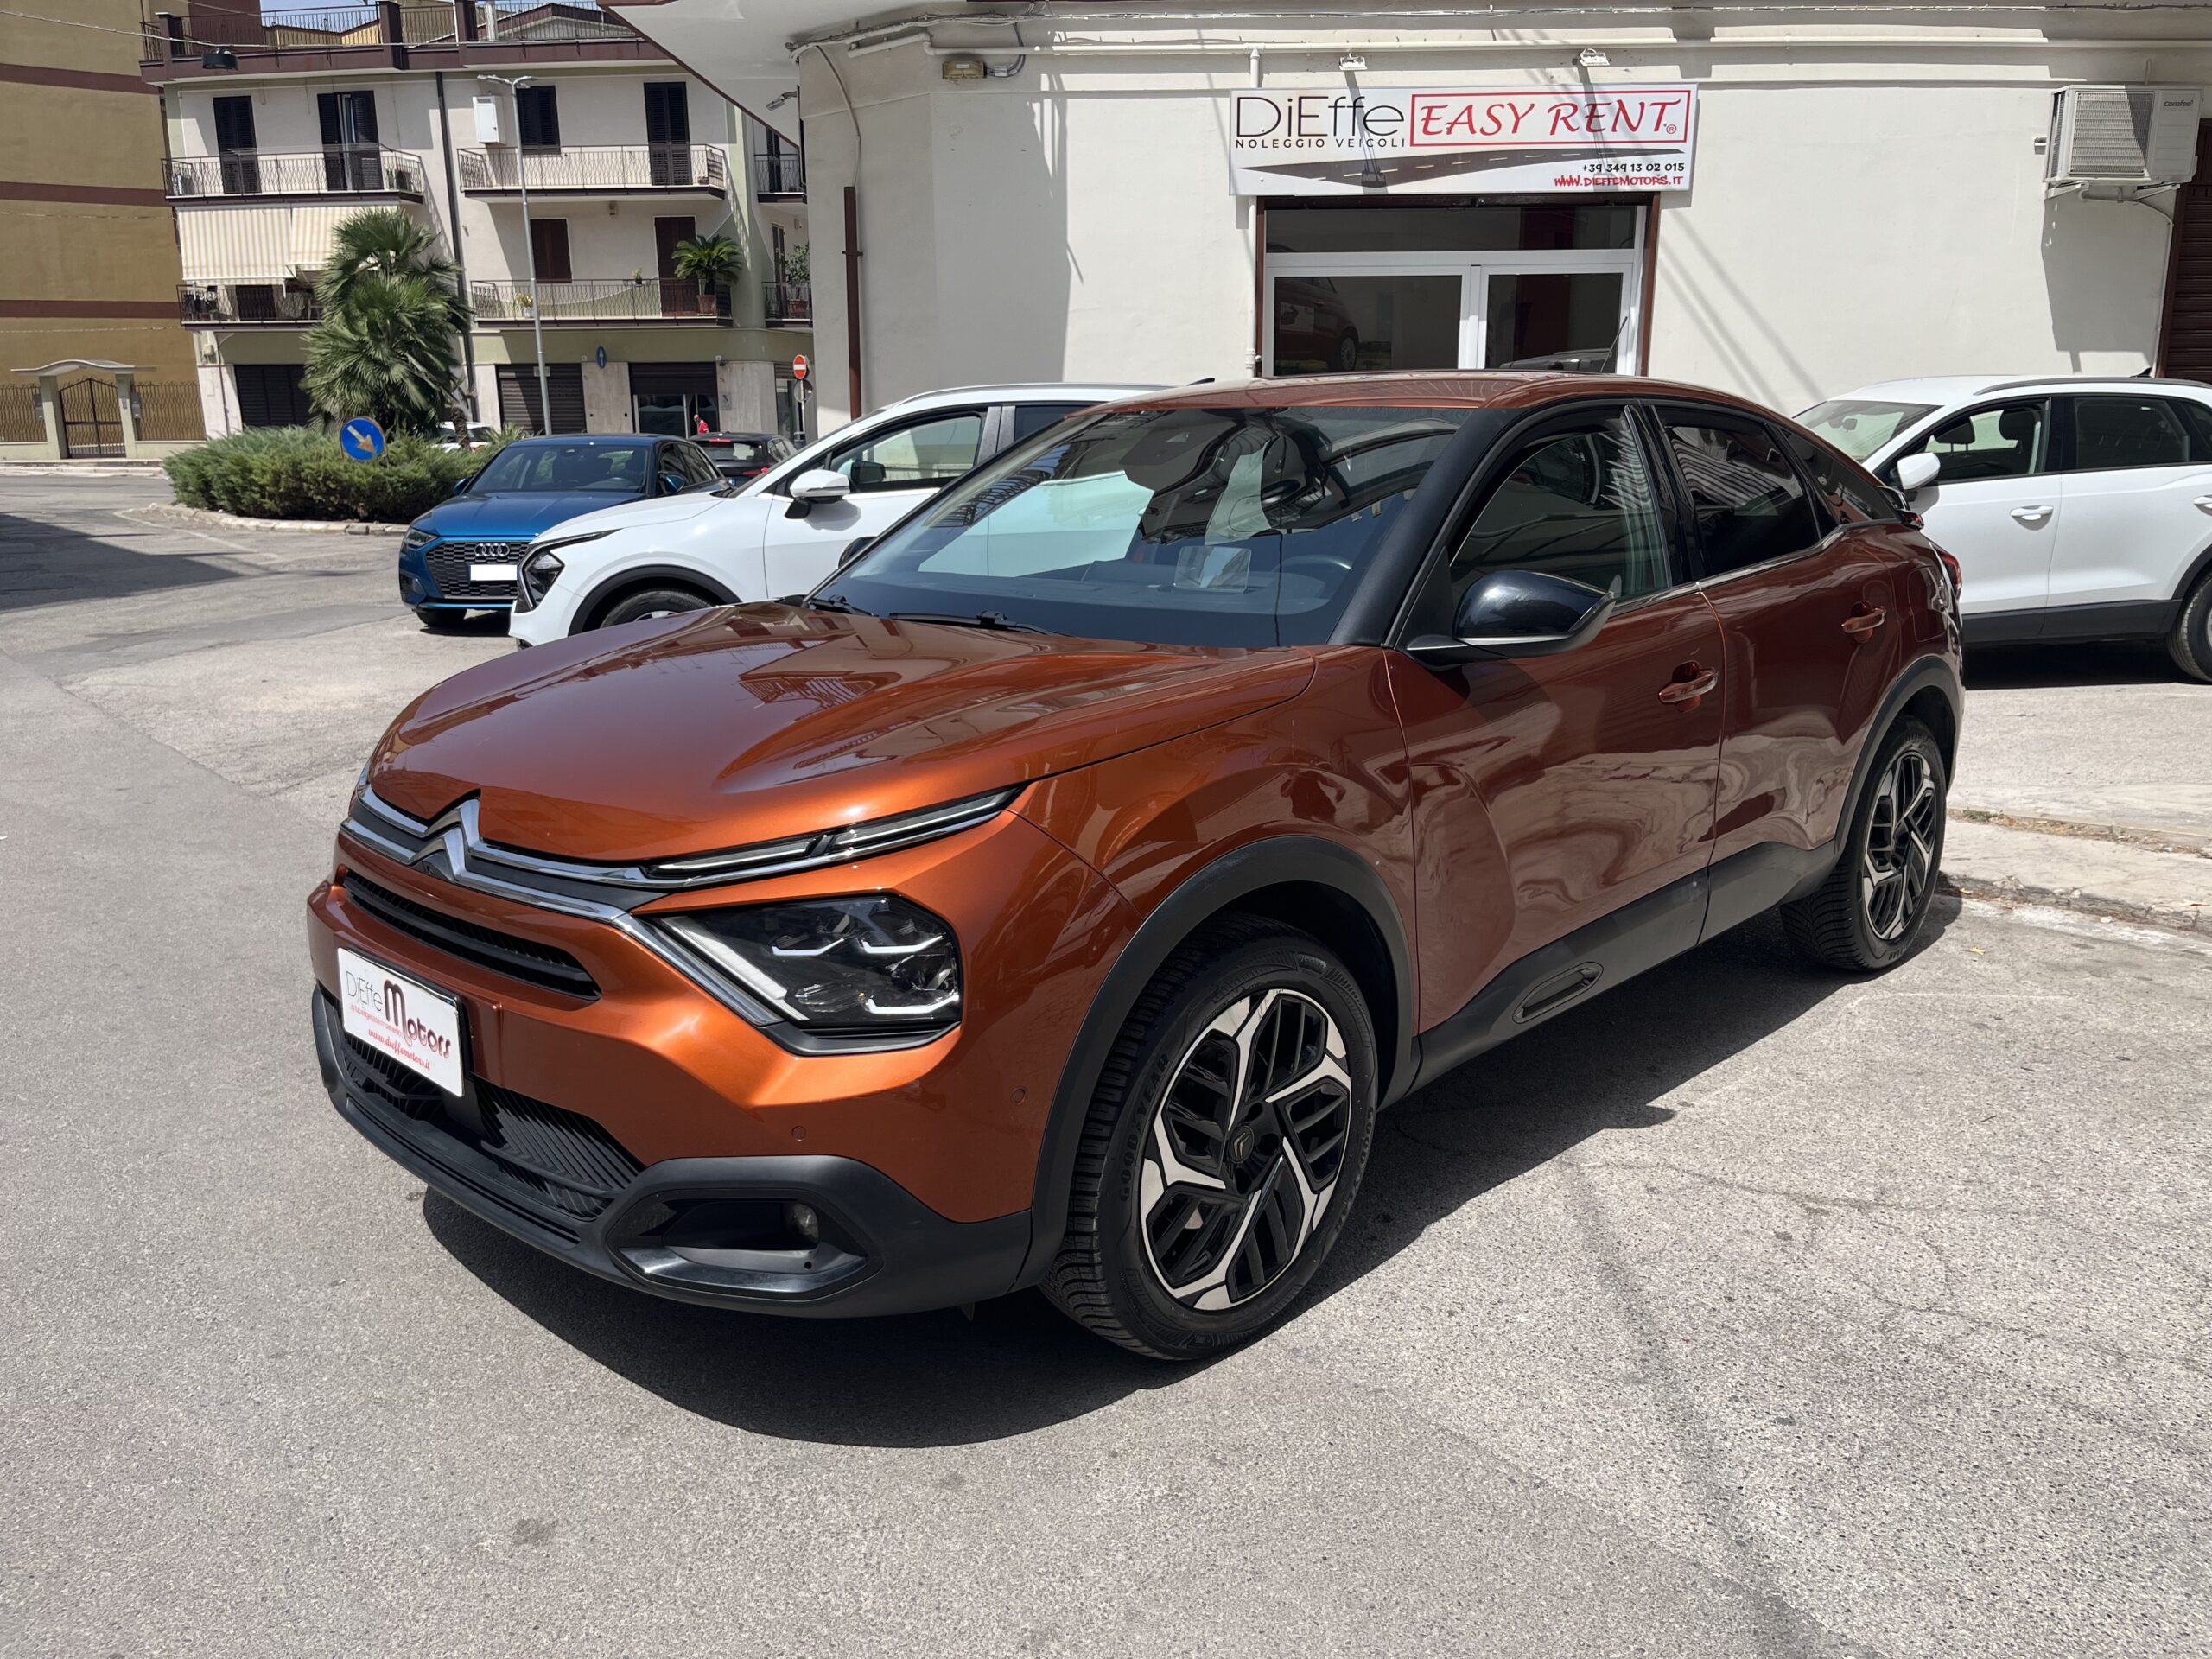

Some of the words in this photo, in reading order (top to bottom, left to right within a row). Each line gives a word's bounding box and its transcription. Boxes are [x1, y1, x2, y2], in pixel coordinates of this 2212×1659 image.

[1236, 96, 1404, 137] DiEffe
[1420, 102, 1535, 136] EASY
[1236, 139, 1325, 149] NOLEGGIO
[1335, 138, 1405, 148] VEICOLI
[1582, 163, 1602, 173] +39
[1606, 163, 1627, 172] 349
[1630, 163, 1643, 172] 13
[1645, 162, 1661, 172] 02
[1664, 162, 1685, 172] 015
[346, 970, 383, 1012] DiEffe
[383, 978, 452, 1059] Motors
[1119, 1052, 1169, 1202] GOODYEAR
